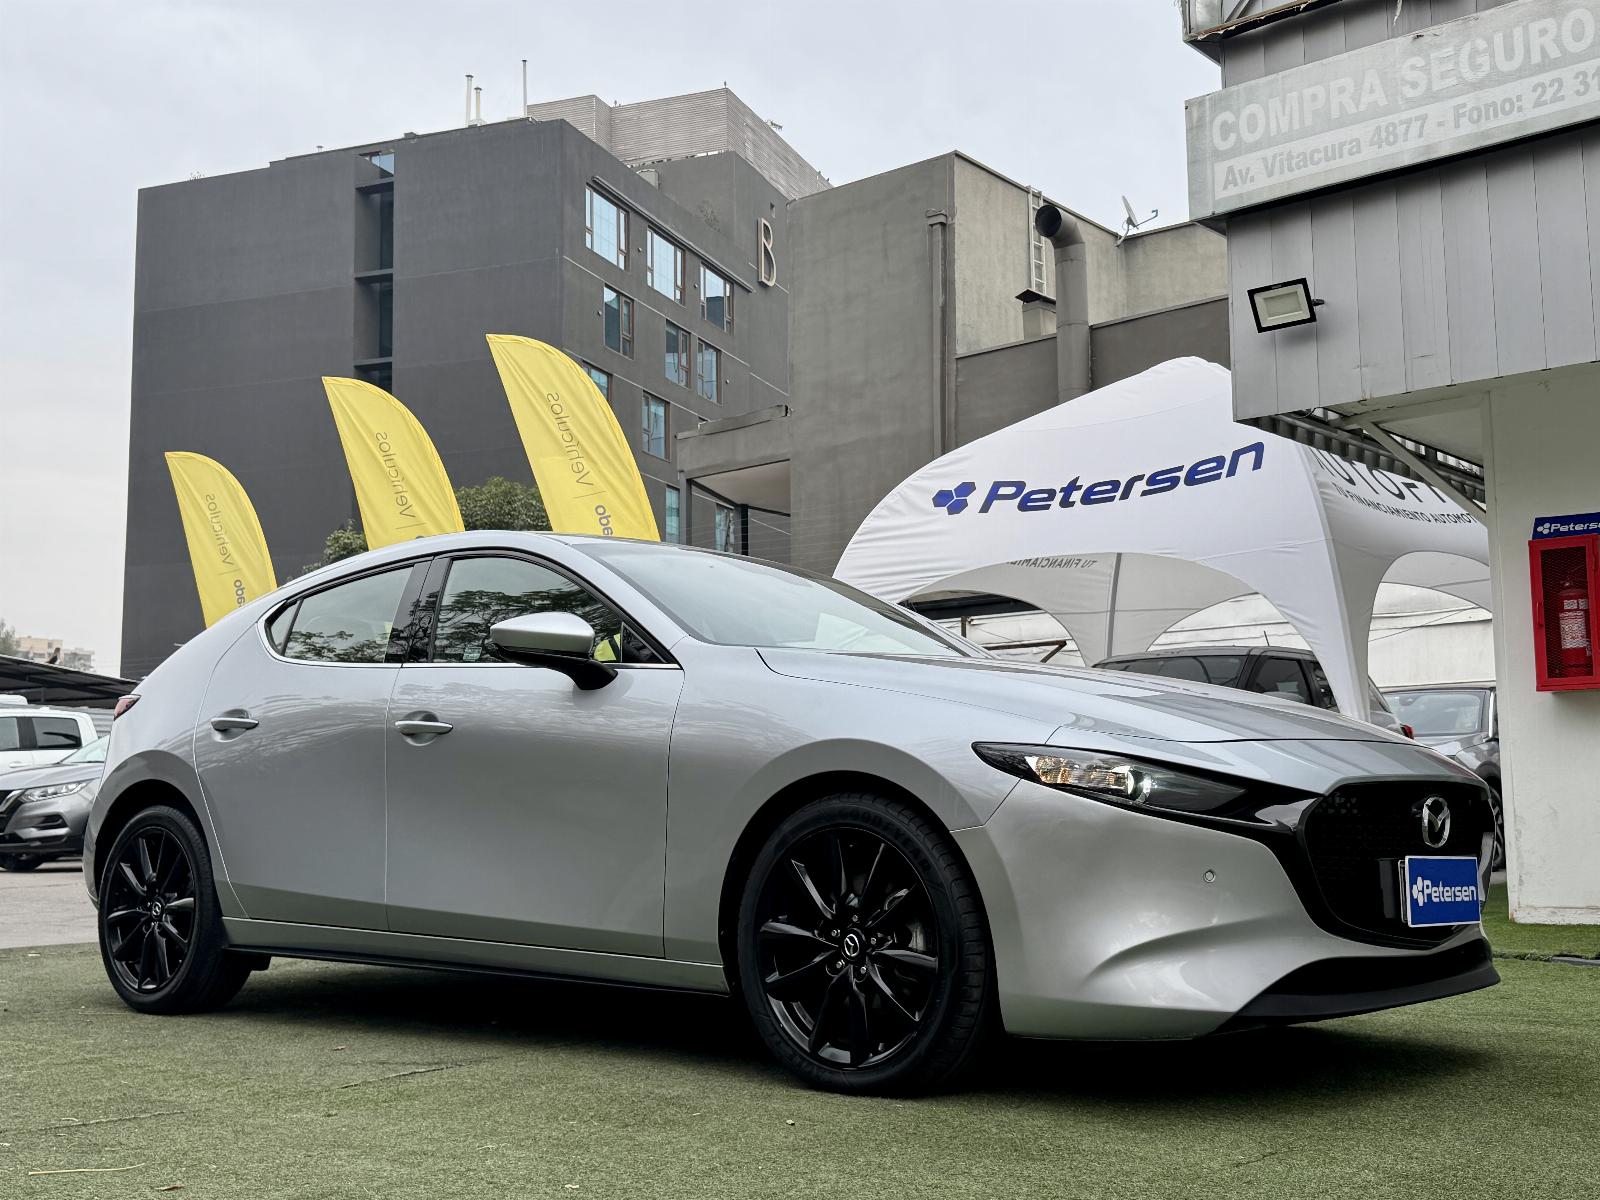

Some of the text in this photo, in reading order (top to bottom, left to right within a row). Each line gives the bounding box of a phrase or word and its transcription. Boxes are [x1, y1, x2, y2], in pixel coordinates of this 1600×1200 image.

[1212, 8, 1595, 151] COMPRA SEGURO
[1222, 165, 1256, 191] Av.
[1261, 136, 1362, 178] Vitacura
[1369, 113, 1429, 149] 4877
[1452, 93, 1524, 129] Fono:
[1531, 77, 1566, 109] 22
[757, 217, 777, 288] B
[977, 441, 1265, 514] Petersen
[1429, 512, 1478, 524] AUTOMOT
[1550, 522, 1600, 533] Peters
[1423, 879, 1477, 903] Petersen
